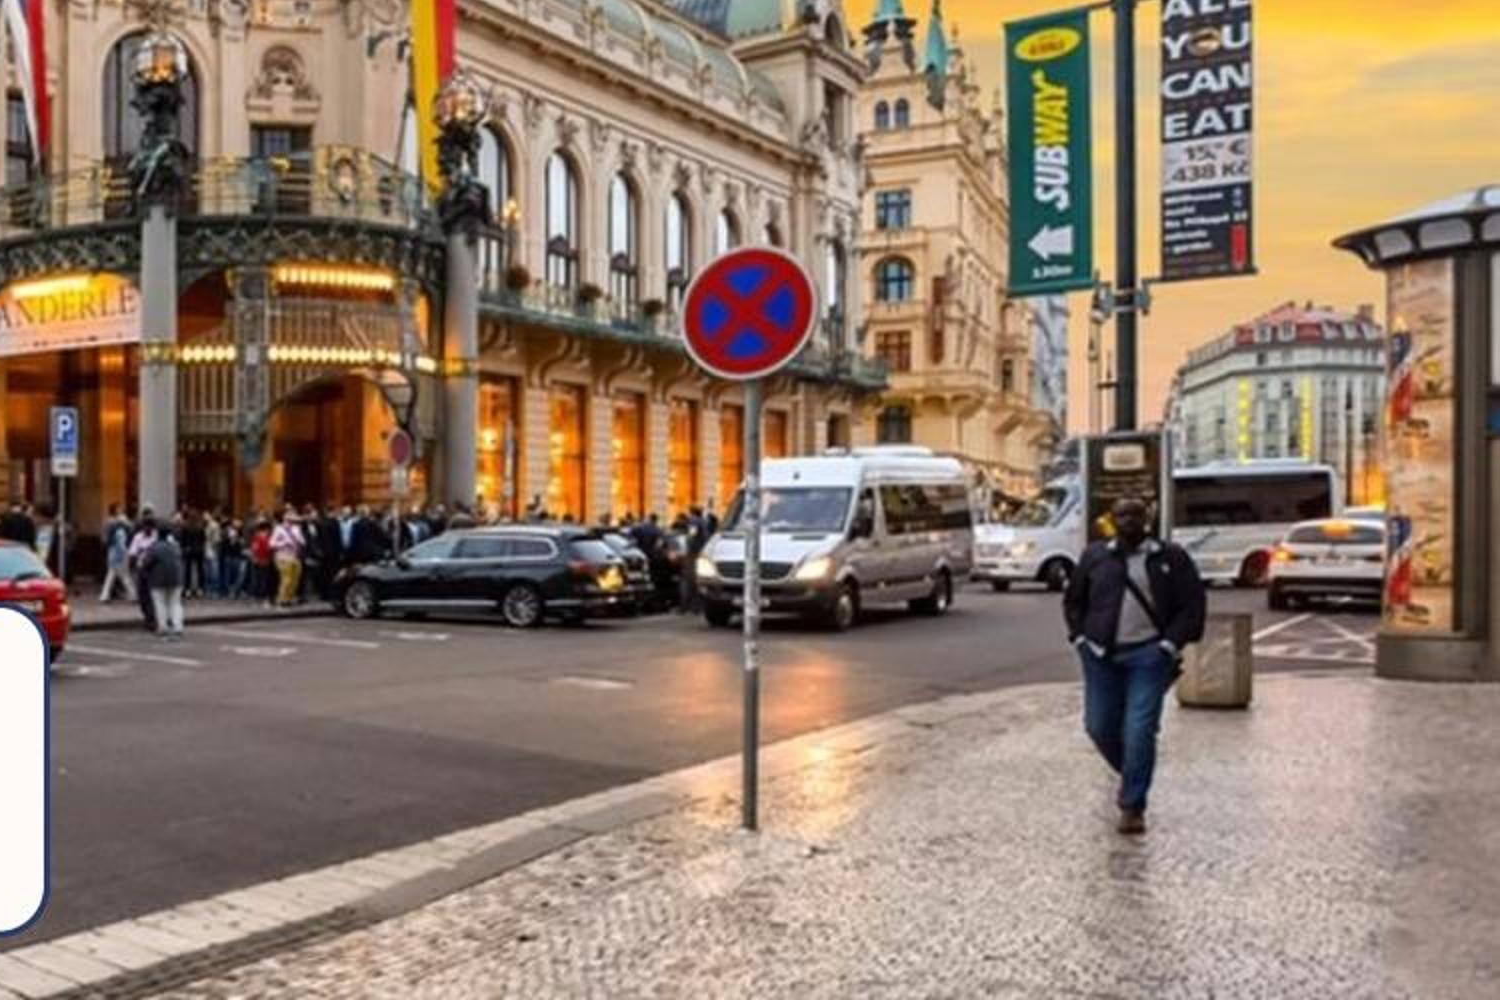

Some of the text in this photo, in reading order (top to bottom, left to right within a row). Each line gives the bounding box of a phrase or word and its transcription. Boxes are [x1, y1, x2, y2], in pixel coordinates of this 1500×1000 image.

[1162, 62, 1251, 99] CAN
[1164, 103, 1251, 139] EAT
[1032, 68, 1071, 212] SUBWAY
[58, 414, 73, 440] P
